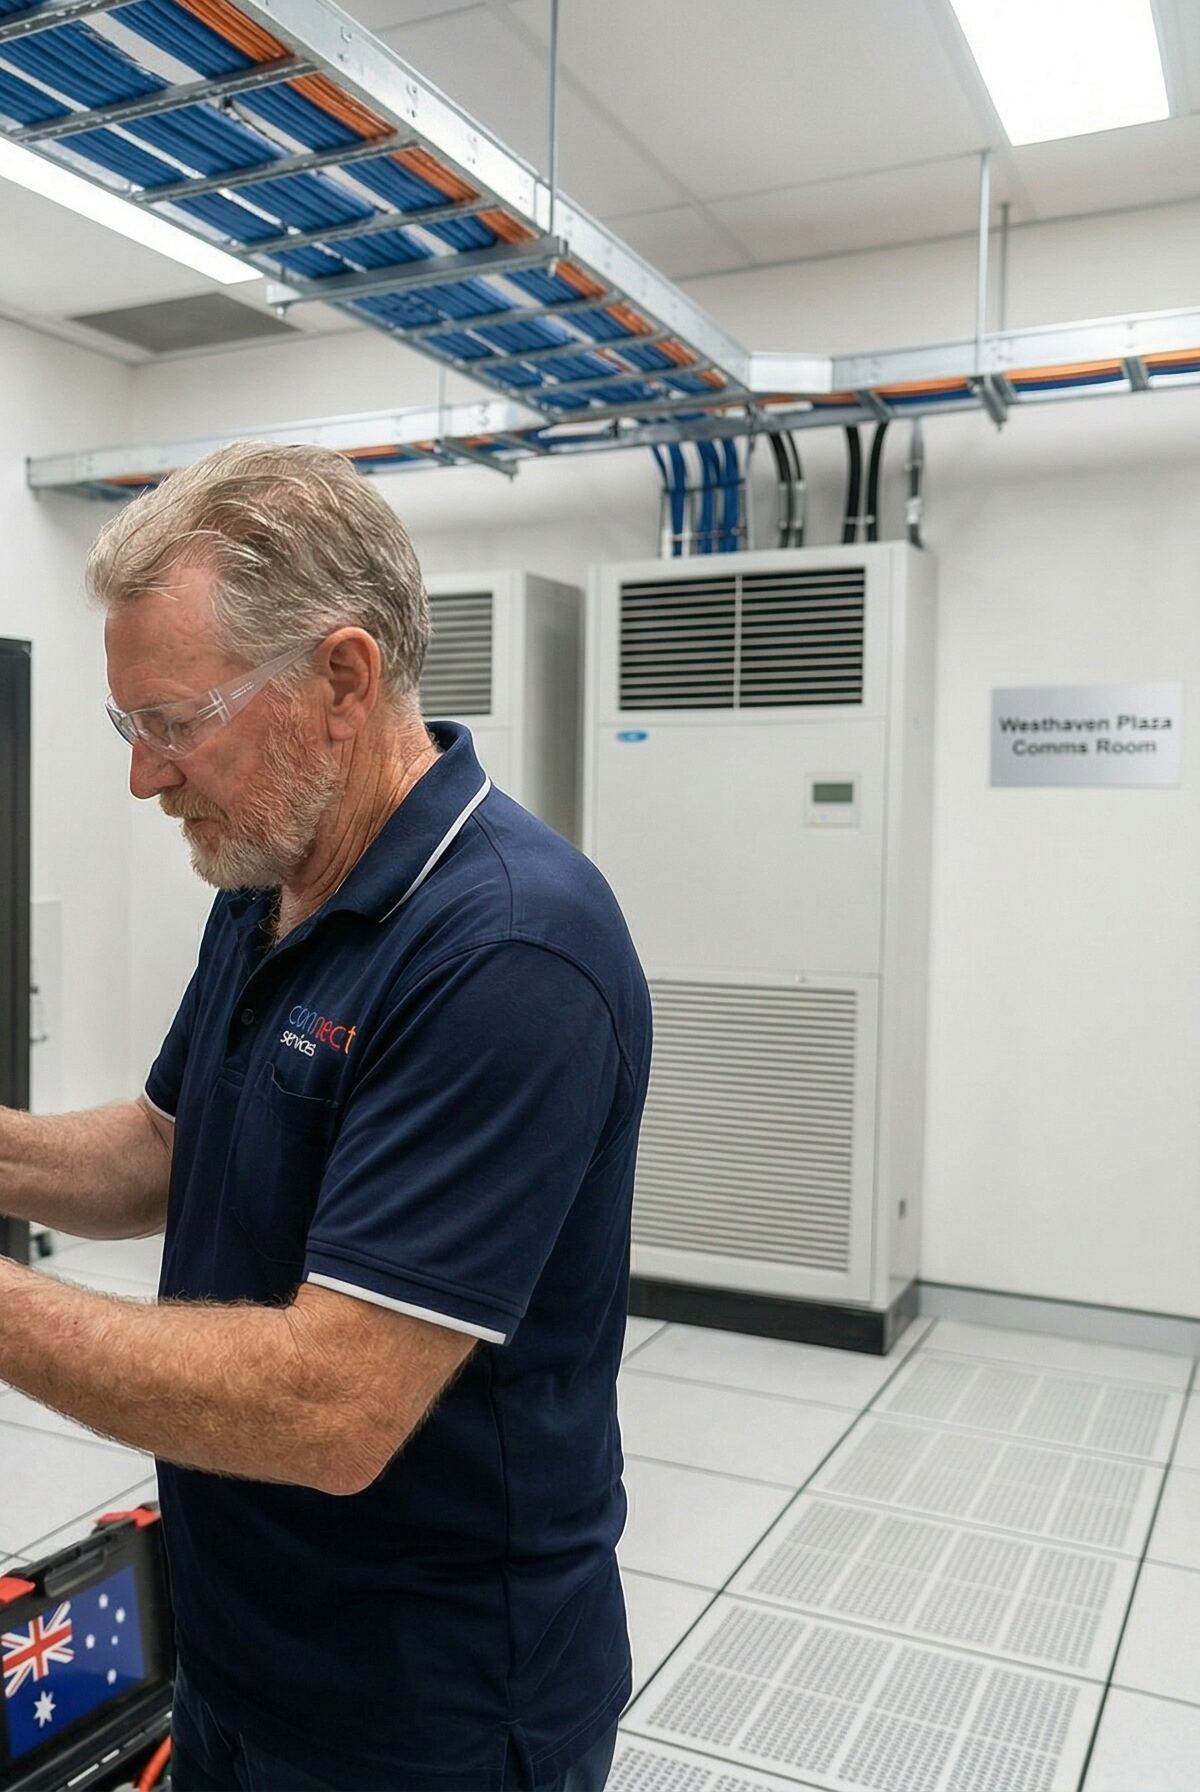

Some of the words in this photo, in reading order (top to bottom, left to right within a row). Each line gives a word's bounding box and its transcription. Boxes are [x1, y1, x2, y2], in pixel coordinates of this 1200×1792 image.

[999, 716, 1111, 734] Westhaven
[1117, 714, 1173, 731] Plaza
[1012, 738, 1089, 756] Comms
[1096, 738, 1158, 754] Room
